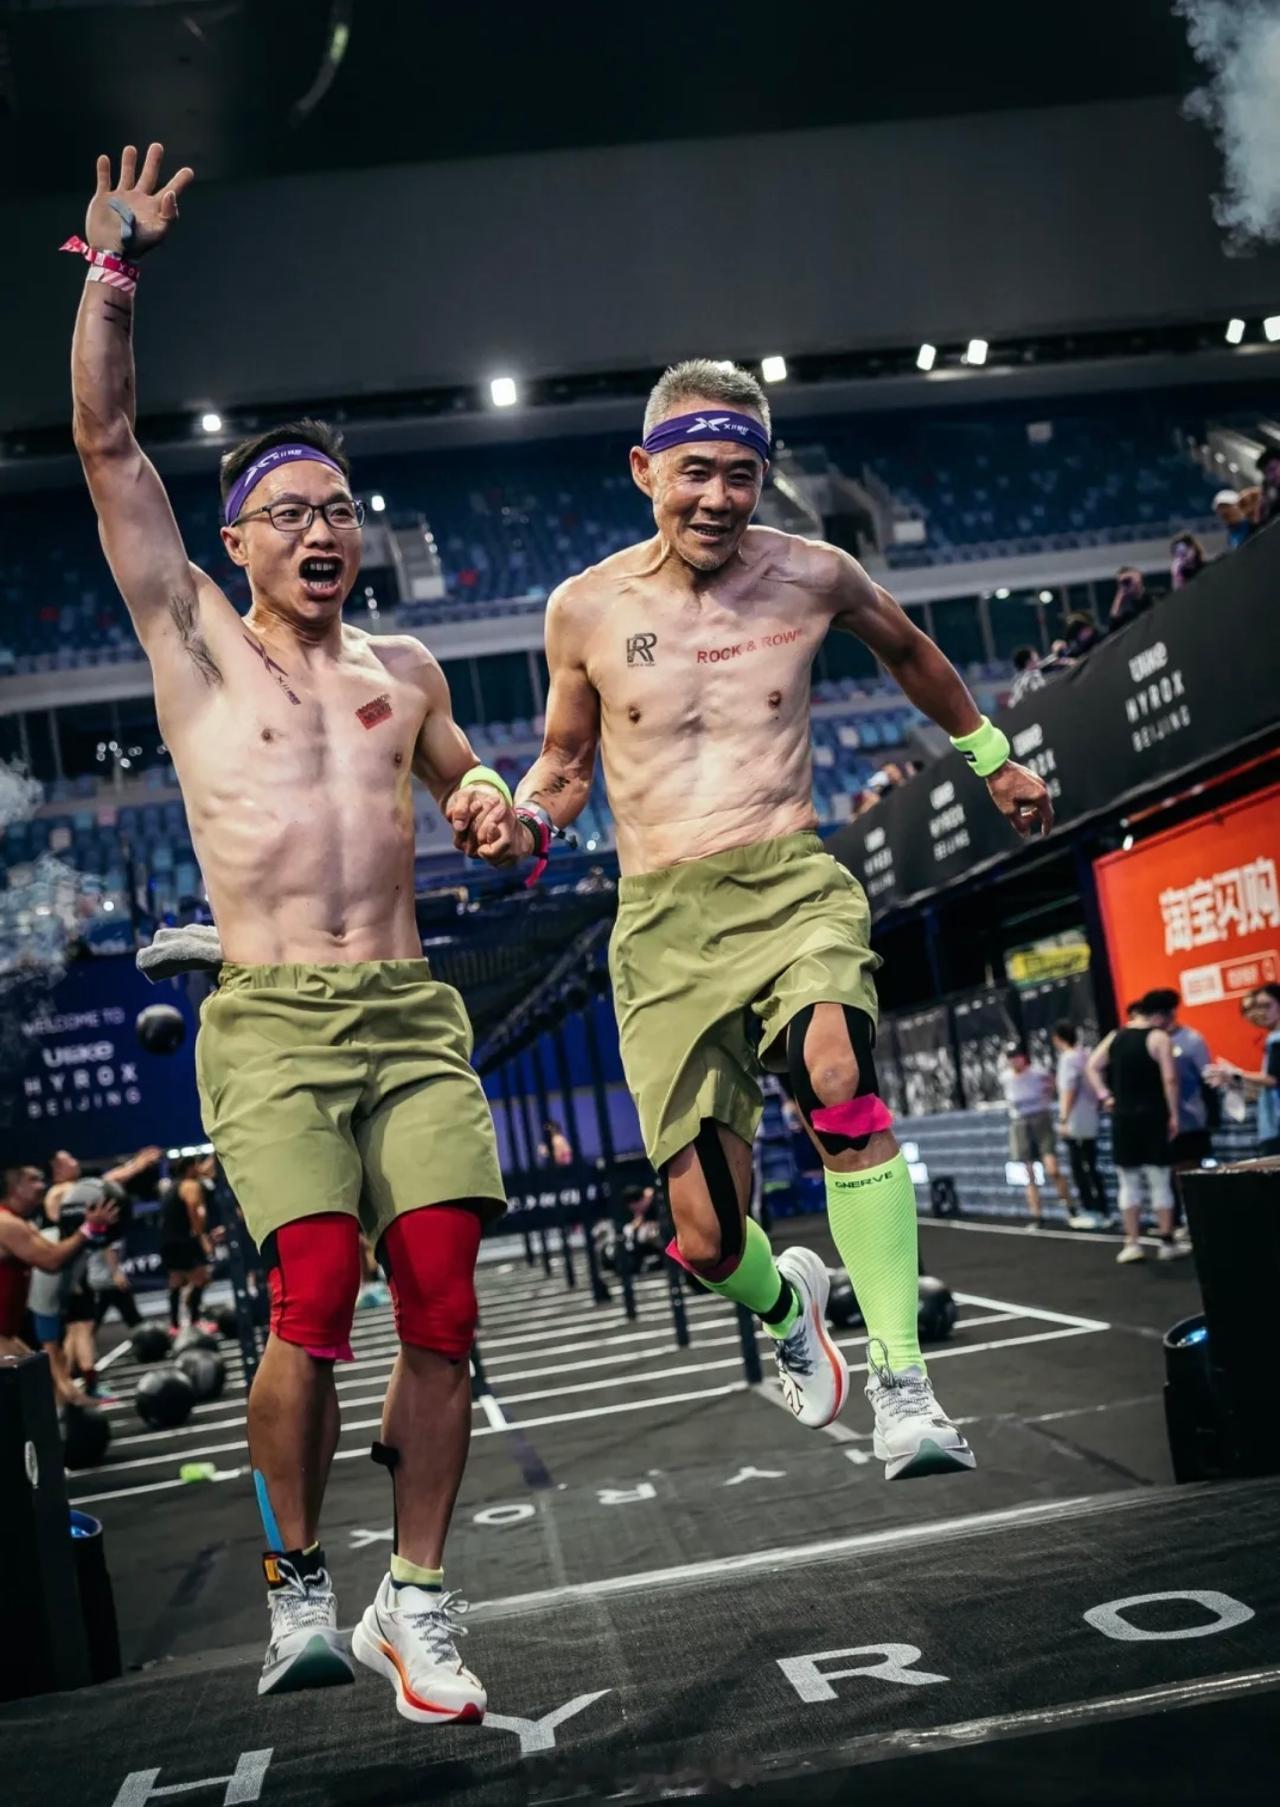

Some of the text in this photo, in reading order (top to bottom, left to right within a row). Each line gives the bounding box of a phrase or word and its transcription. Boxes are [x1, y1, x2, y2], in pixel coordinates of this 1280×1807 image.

[697, 645, 742, 663] ROCK
[747, 640, 757, 652] &
[1125, 669, 1185, 723] HYROX
[24, 1062, 138, 1097] HYROX
